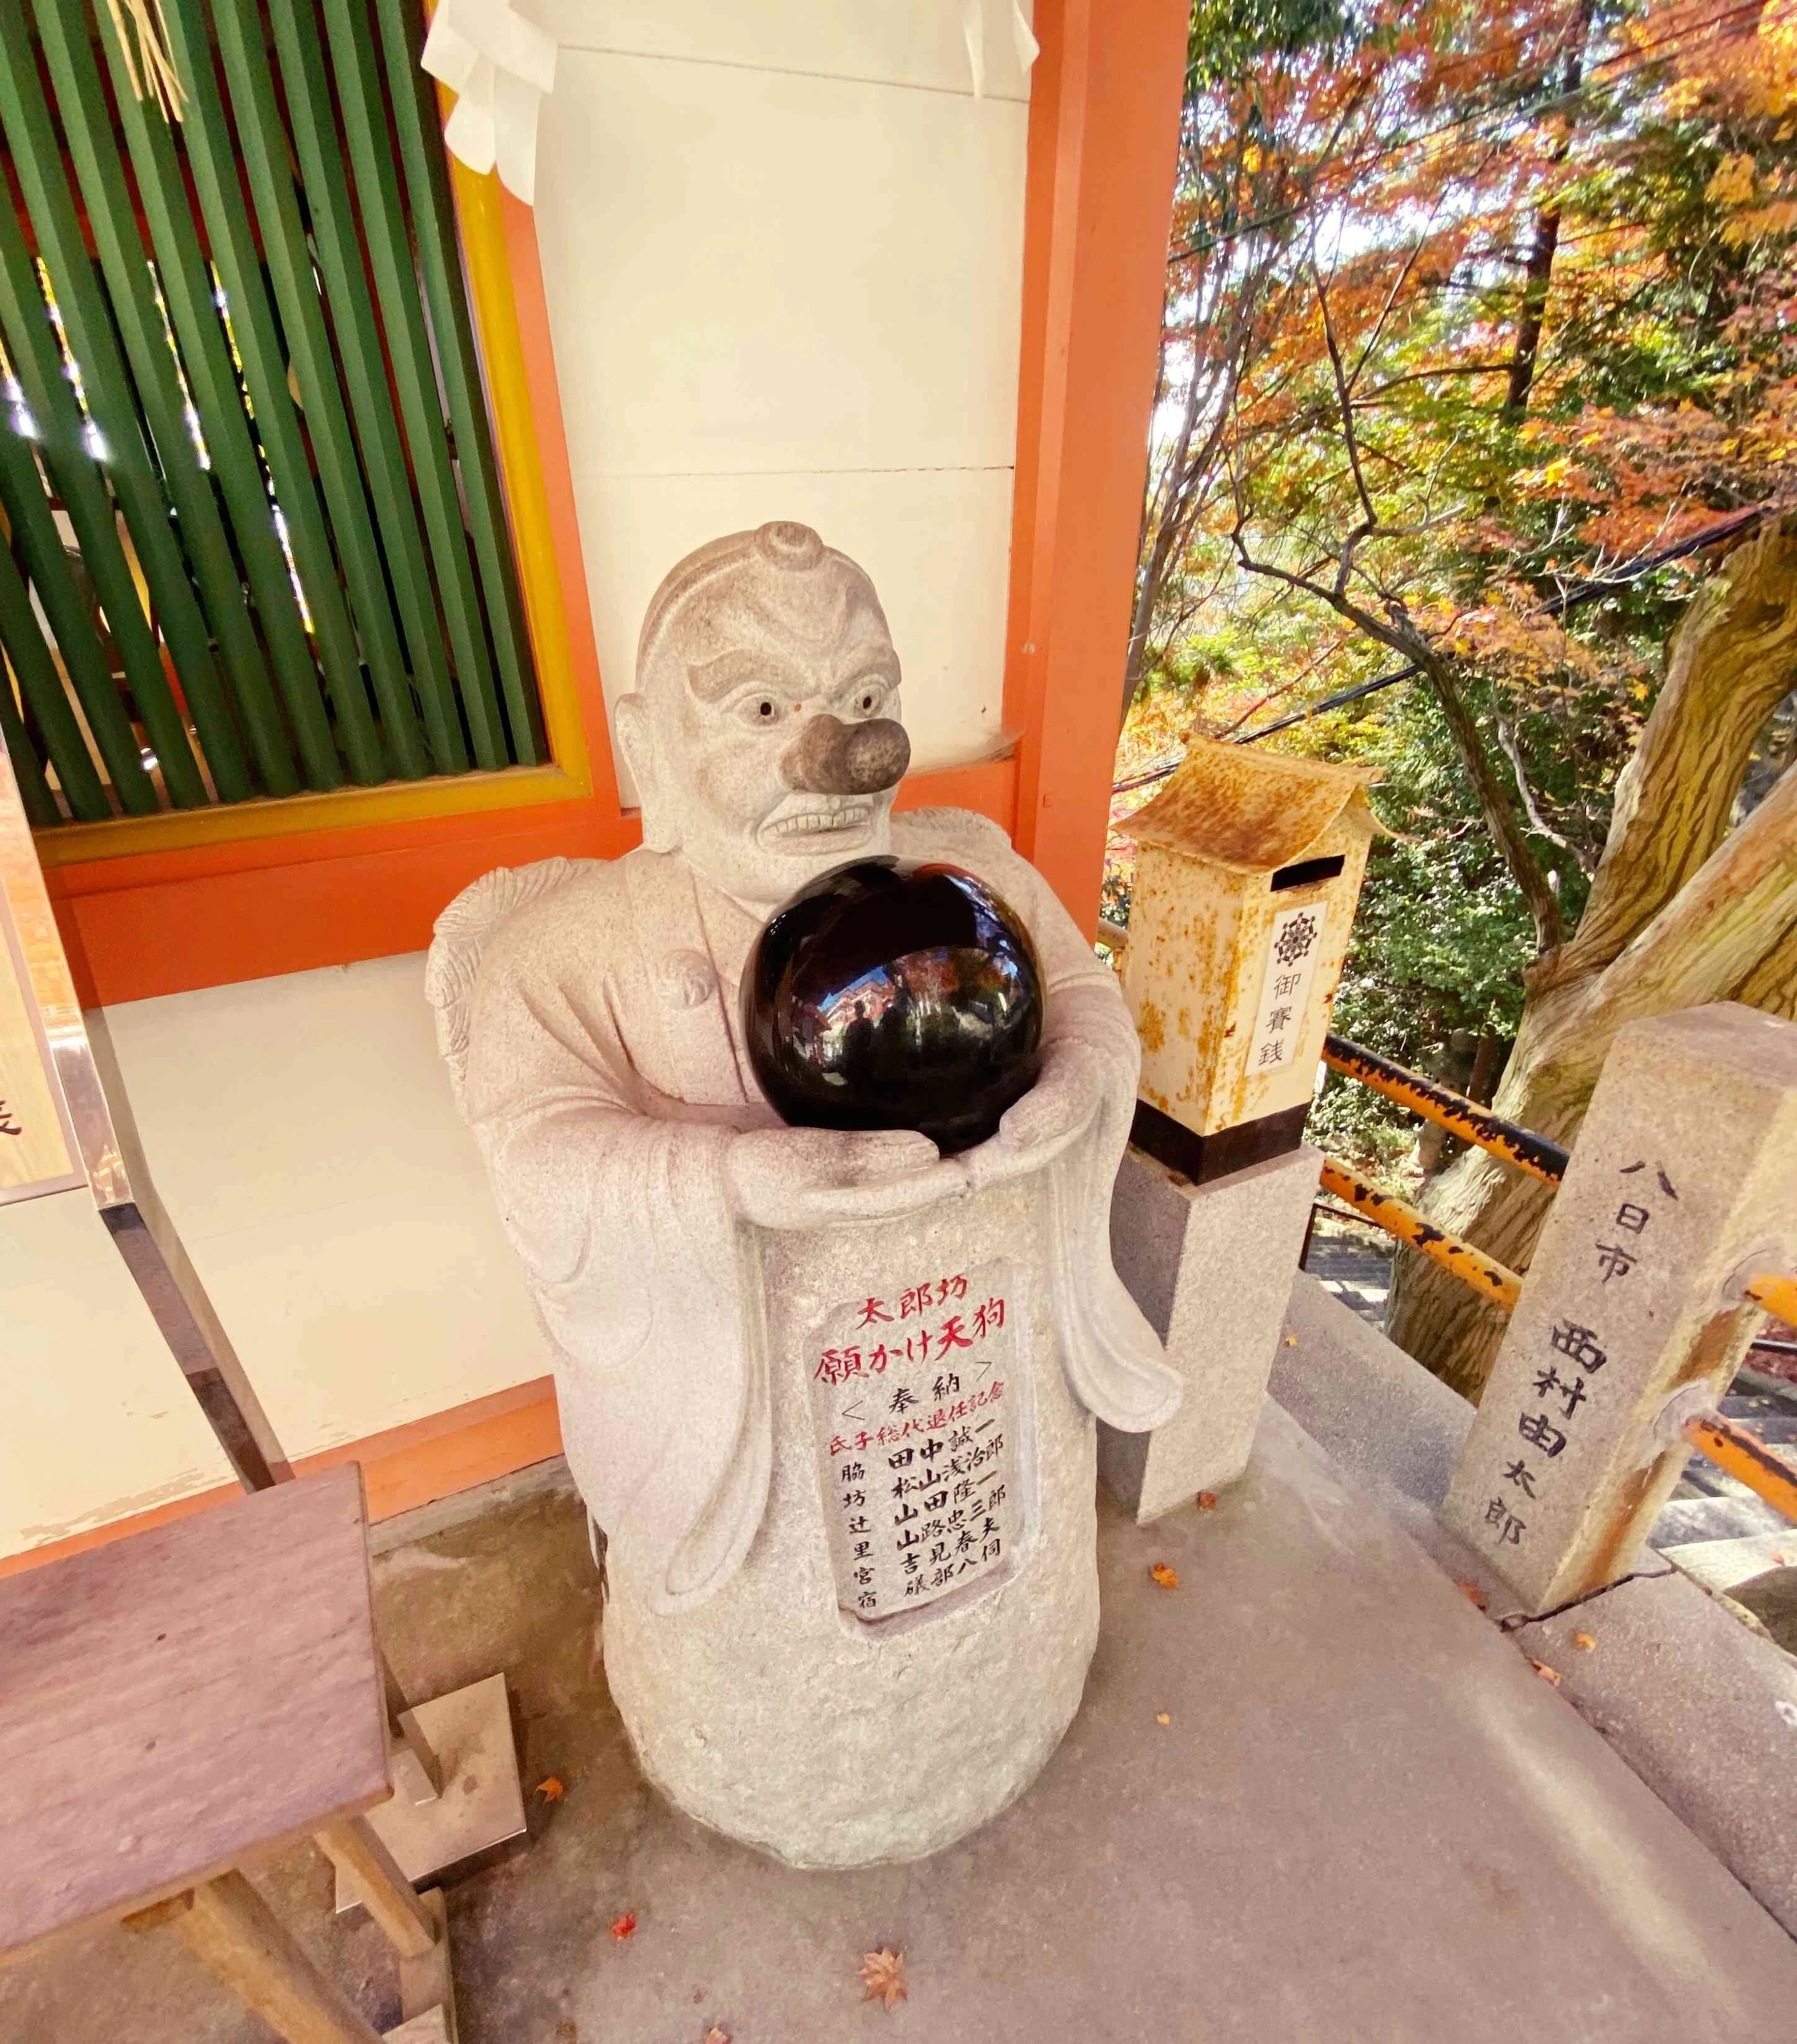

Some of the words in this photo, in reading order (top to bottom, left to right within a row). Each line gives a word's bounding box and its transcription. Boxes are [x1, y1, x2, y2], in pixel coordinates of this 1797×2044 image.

[1259, 973, 1301, 1066] 御賽銭
[1595, 1160, 1679, 1285] 八日市
[856, 1274, 968, 1330] 太郎坊
[813, 1297, 1005, 1386] 願かけ天狗
[830, 1381, 1004, 1457] 氏子総代退任記念
[888, 1419, 996, 1470] 田中誠一
[1483, 1318, 1608, 1546] 西村由太郎
[896, 1484, 1006, 1551] 山路忠三郎
[899, 1517, 1001, 1575] 吉見春夫
